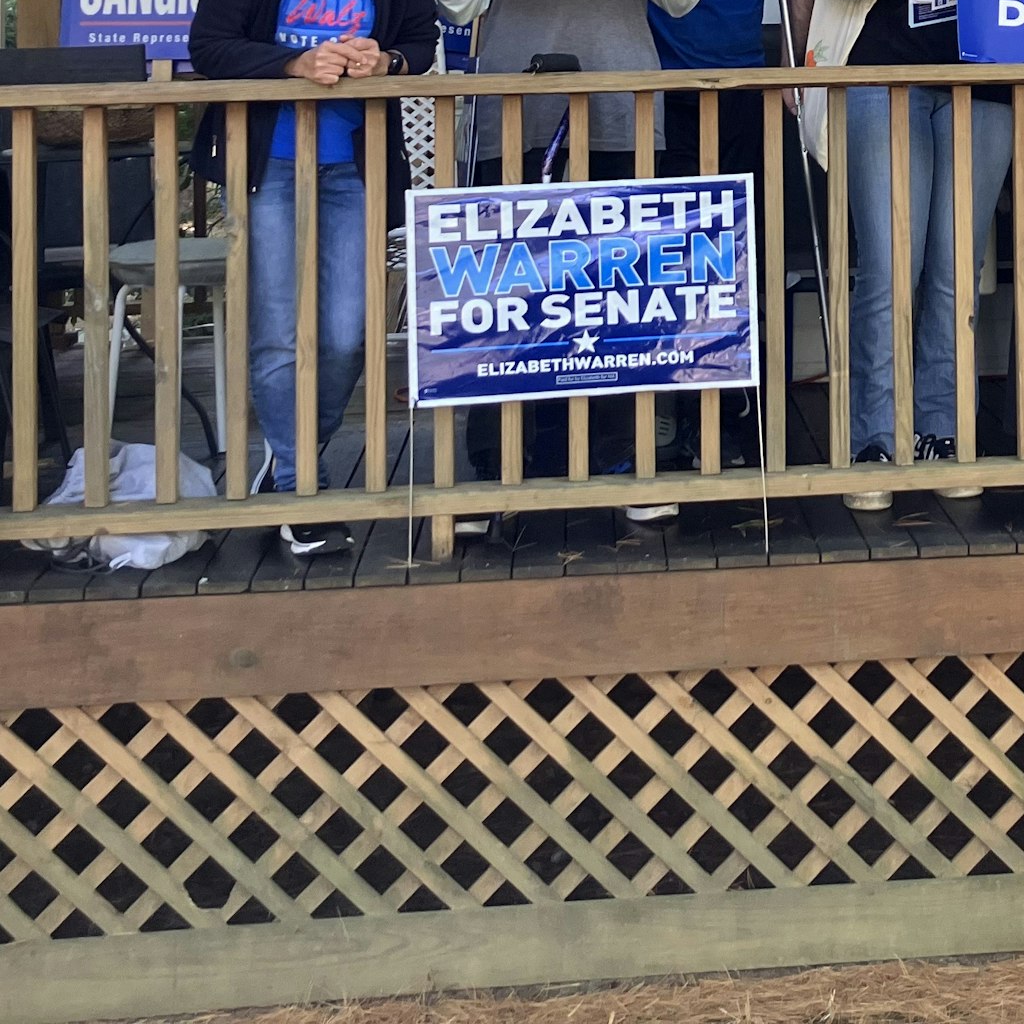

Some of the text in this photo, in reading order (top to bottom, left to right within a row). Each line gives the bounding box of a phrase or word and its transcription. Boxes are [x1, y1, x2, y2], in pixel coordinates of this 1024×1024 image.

[88, 33, 126, 43] State
[427, 189, 735, 243] ELIZABETH
[428, 230, 737, 297] WARREN
[429, 284, 738, 337] FOR SENATE
[476, 350, 695, 378] ELIZABETHWARREN.COM
